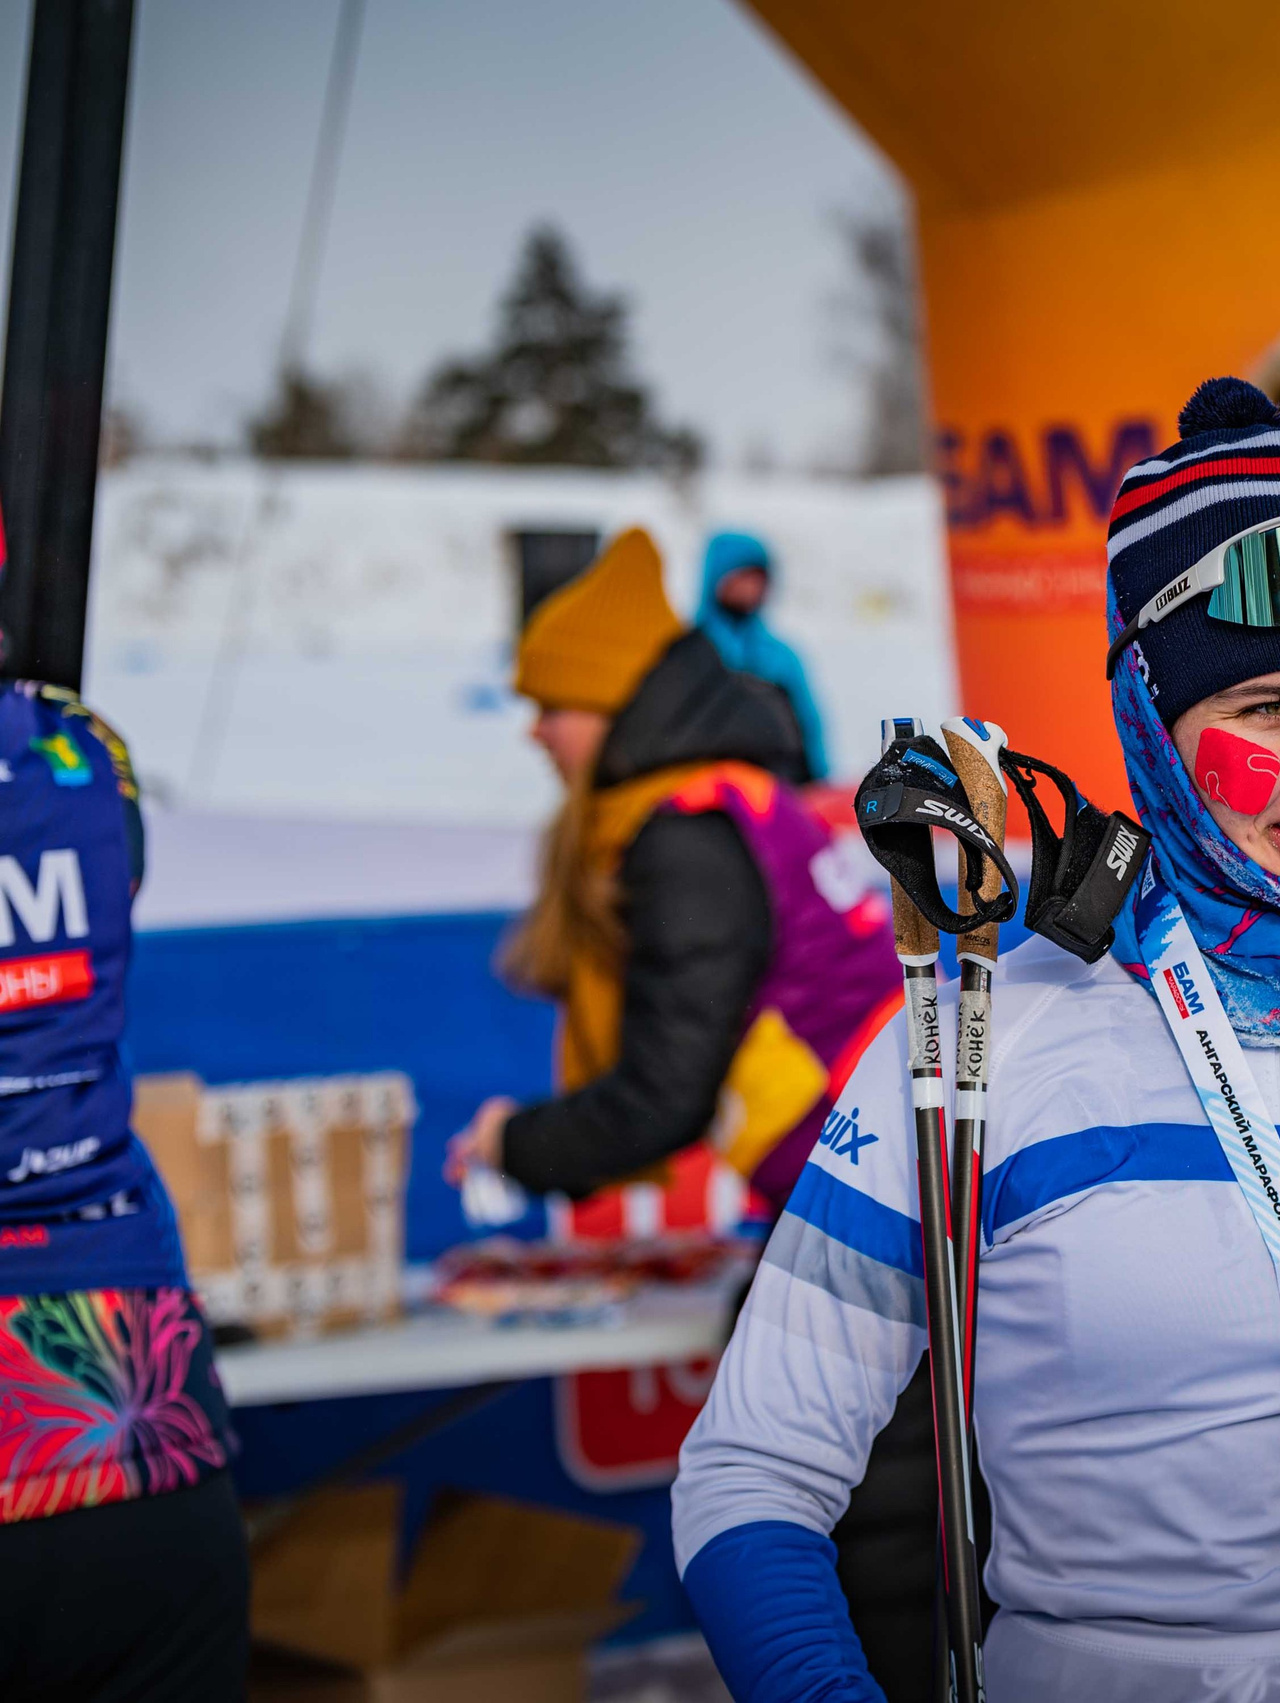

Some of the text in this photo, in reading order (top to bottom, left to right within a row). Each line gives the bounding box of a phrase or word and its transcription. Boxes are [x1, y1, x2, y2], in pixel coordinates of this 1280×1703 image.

[866, 800, 877, 814] R
[1172, 961, 1205, 1016] БАМ
[1195, 1029, 1252, 1134] АНГАРСКИЙ
